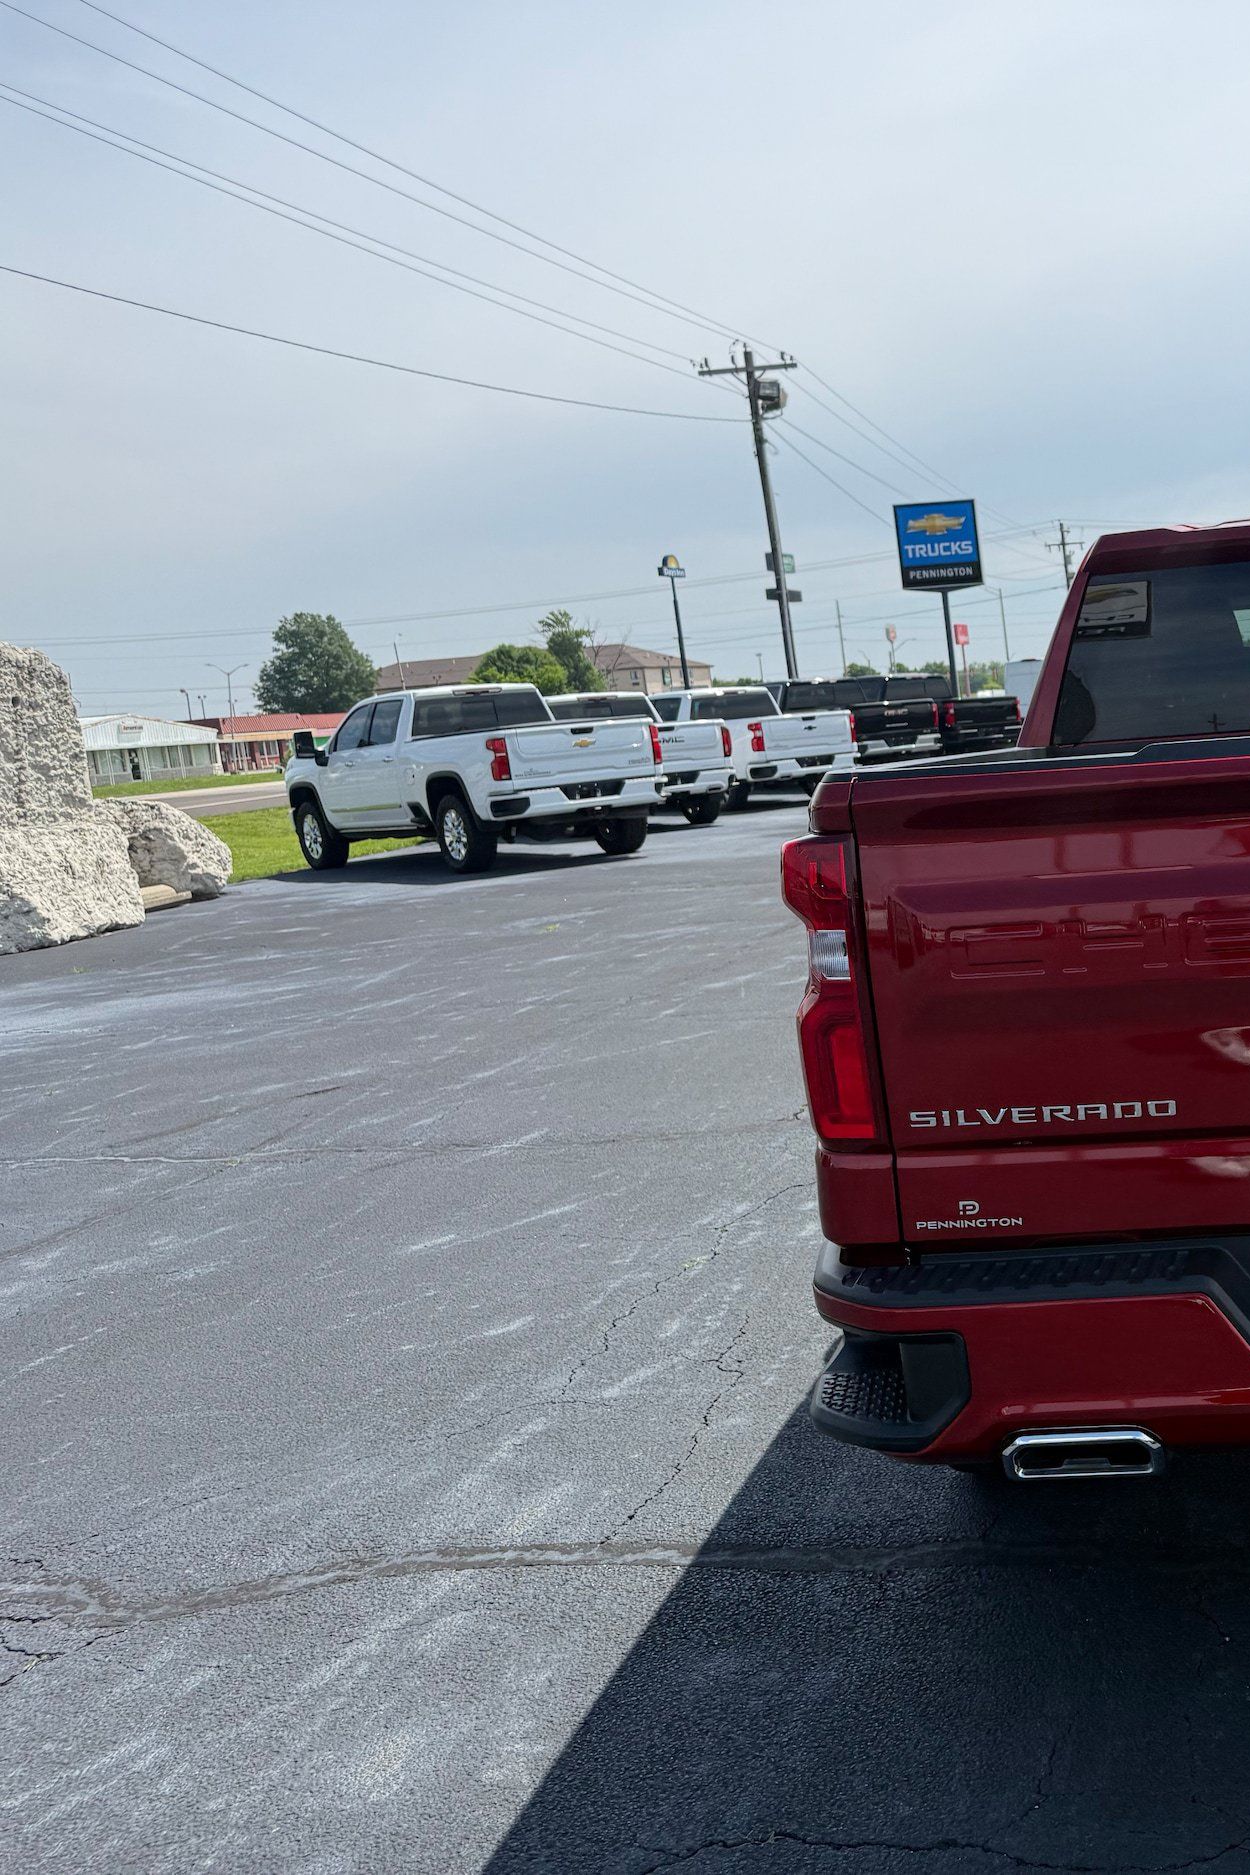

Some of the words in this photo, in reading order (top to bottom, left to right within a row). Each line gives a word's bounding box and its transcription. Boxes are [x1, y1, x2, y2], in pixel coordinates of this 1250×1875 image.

[904, 540, 973, 559] TRUCKS
[909, 566, 973, 580] PENNINGTON
[658, 736, 685, 744] MC
[909, 1099, 1178, 1128] SILVERADO
[916, 1217, 1023, 1230] PENNINGTON
